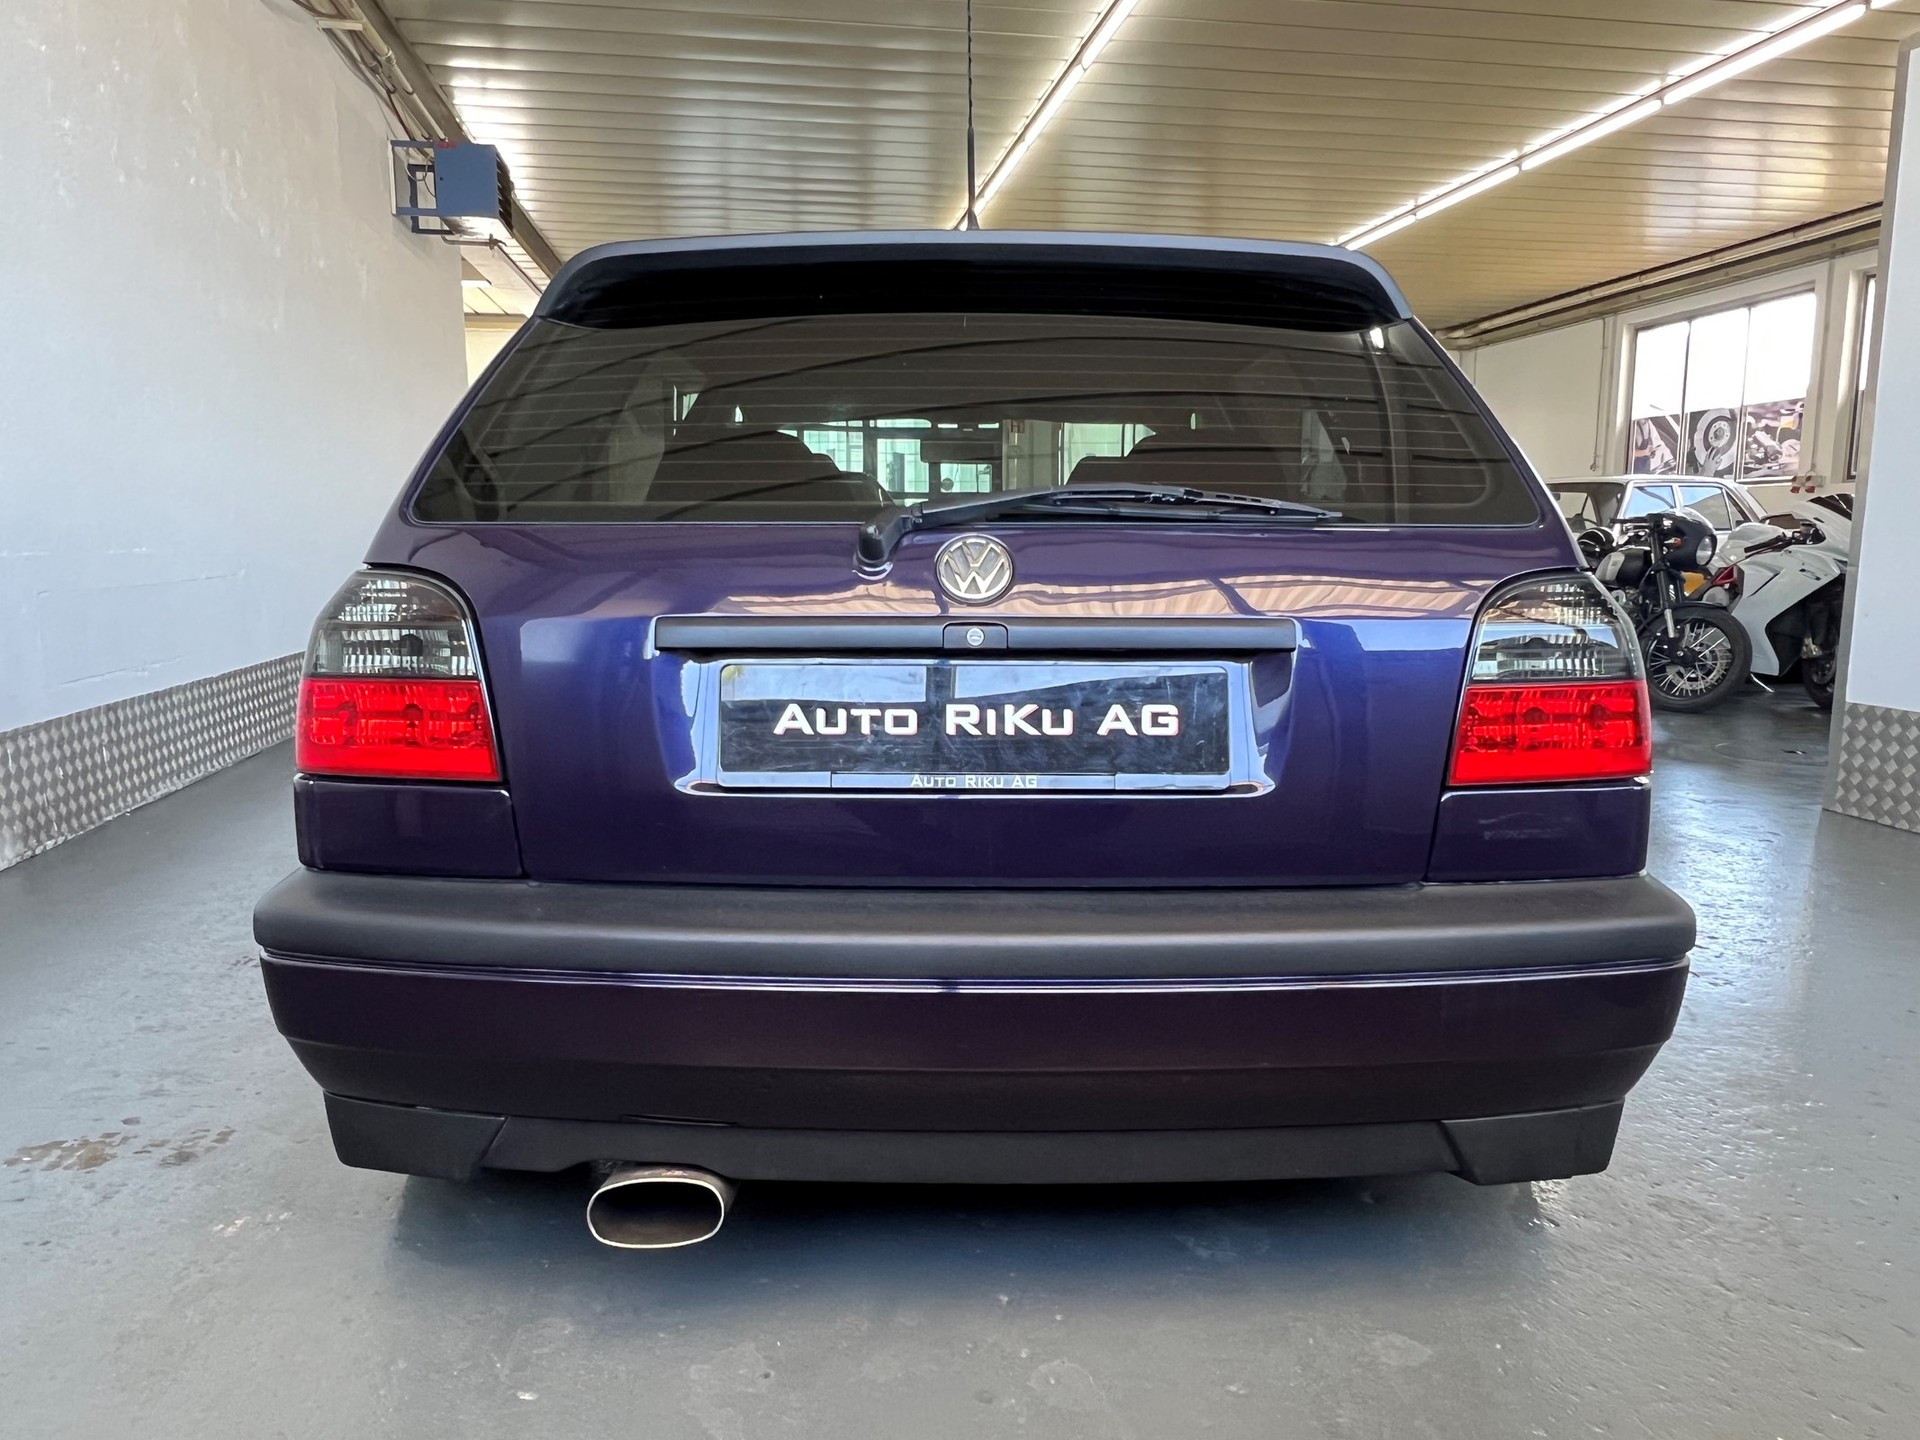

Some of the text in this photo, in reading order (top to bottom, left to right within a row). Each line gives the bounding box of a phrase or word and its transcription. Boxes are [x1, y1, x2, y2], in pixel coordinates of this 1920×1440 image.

[939, 536, 1012, 602] VW
[1097, 703, 1179, 736] AG
[1011, 774, 1038, 788] AG
